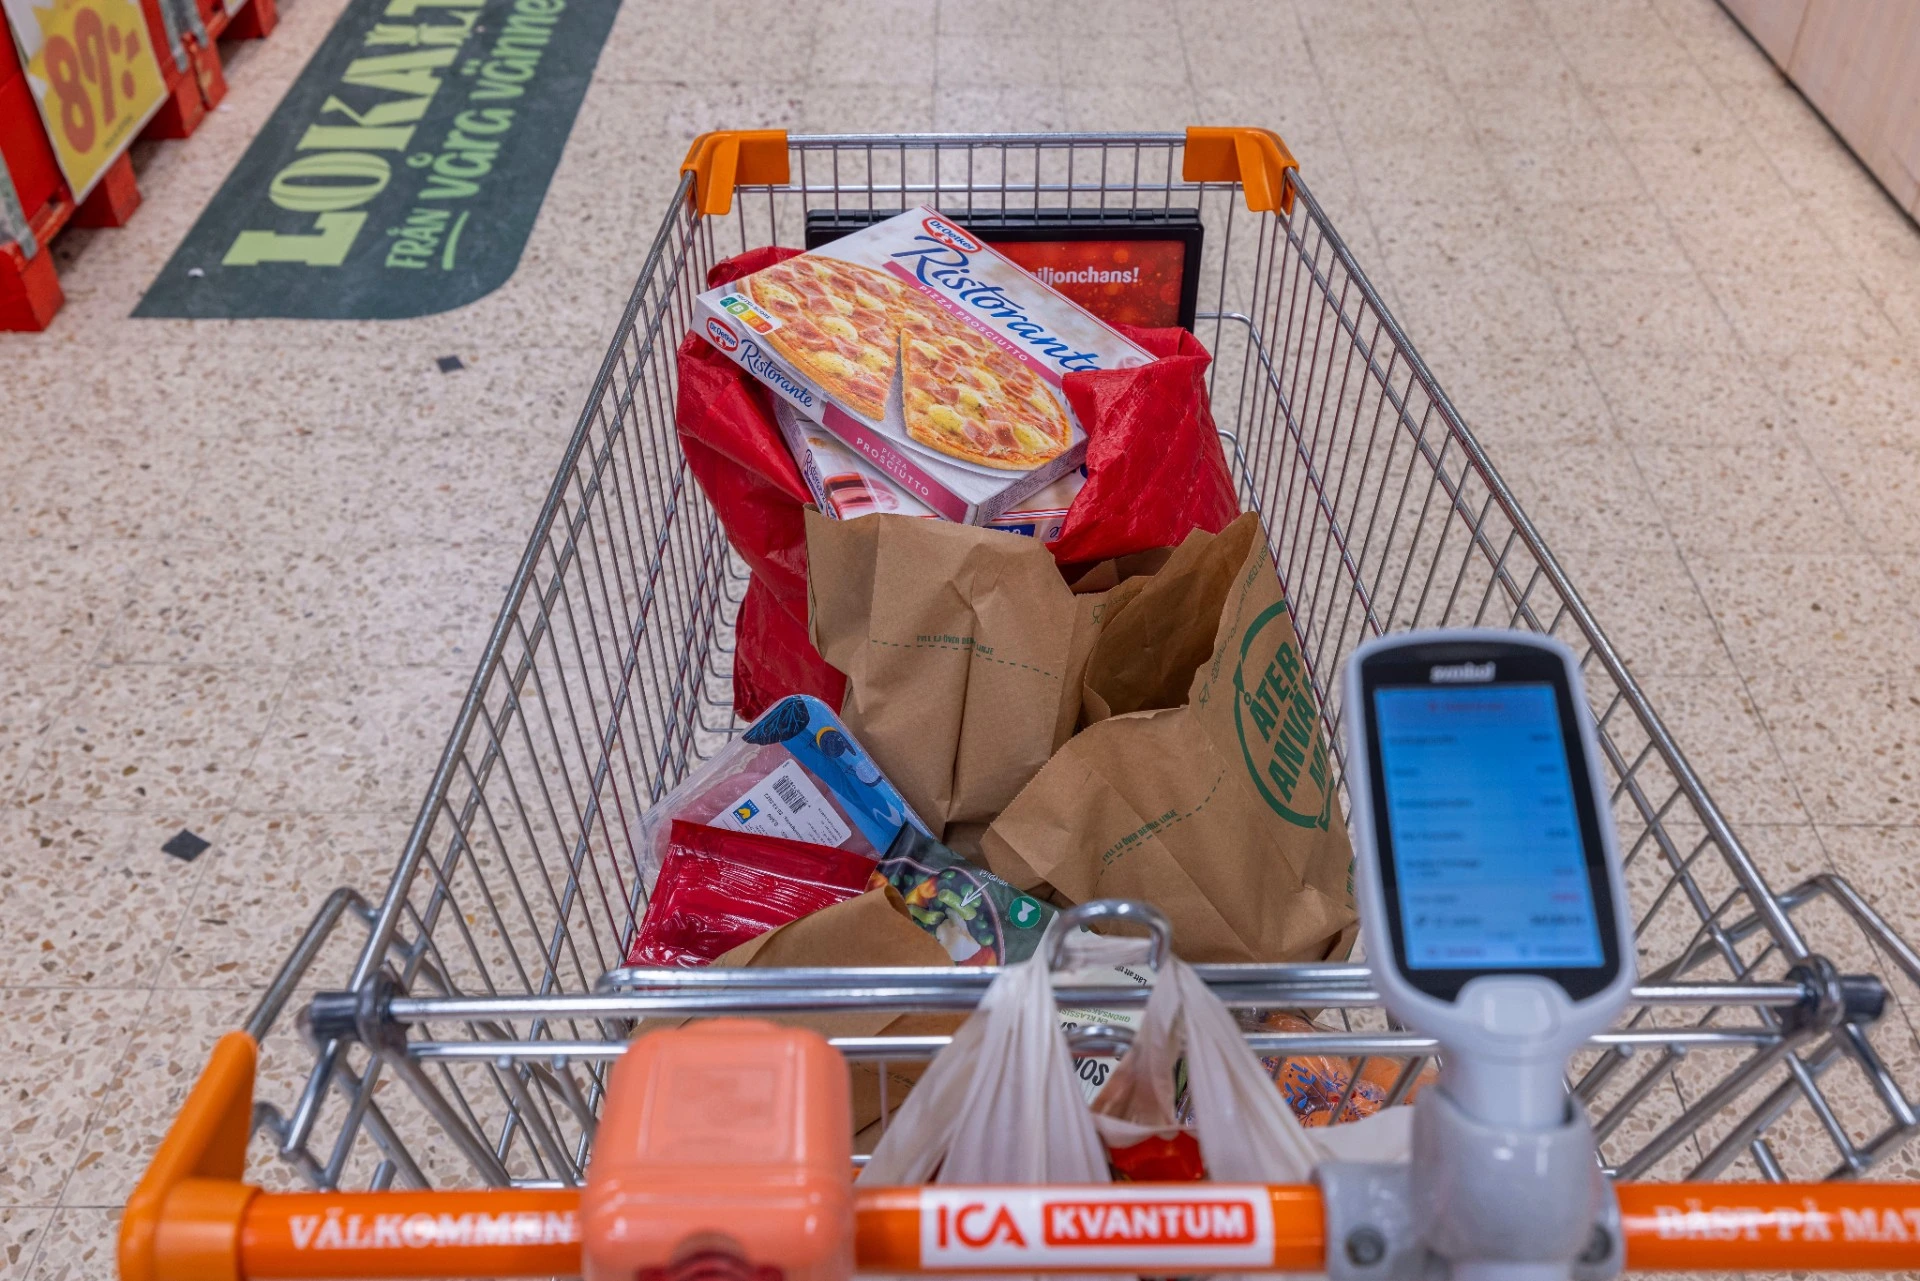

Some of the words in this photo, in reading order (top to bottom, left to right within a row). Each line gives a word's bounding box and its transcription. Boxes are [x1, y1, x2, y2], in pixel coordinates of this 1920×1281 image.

[406, 108, 516, 200] våra
[385, 207, 450, 269] FRÅN
[918, 285, 953, 310] PIZZA
[956, 311, 1030, 362] PROSCIUTTO
[740, 339, 813, 408] Ristorante
[856, 437, 930, 496] PROSCIUTTO
[881, 446, 908, 470] PIZZA
[288, 1207, 578, 1249] VÄLKOMMEN
[937, 1203, 1027, 1249] ICA
[1051, 1204, 1249, 1239] KVANTUM
